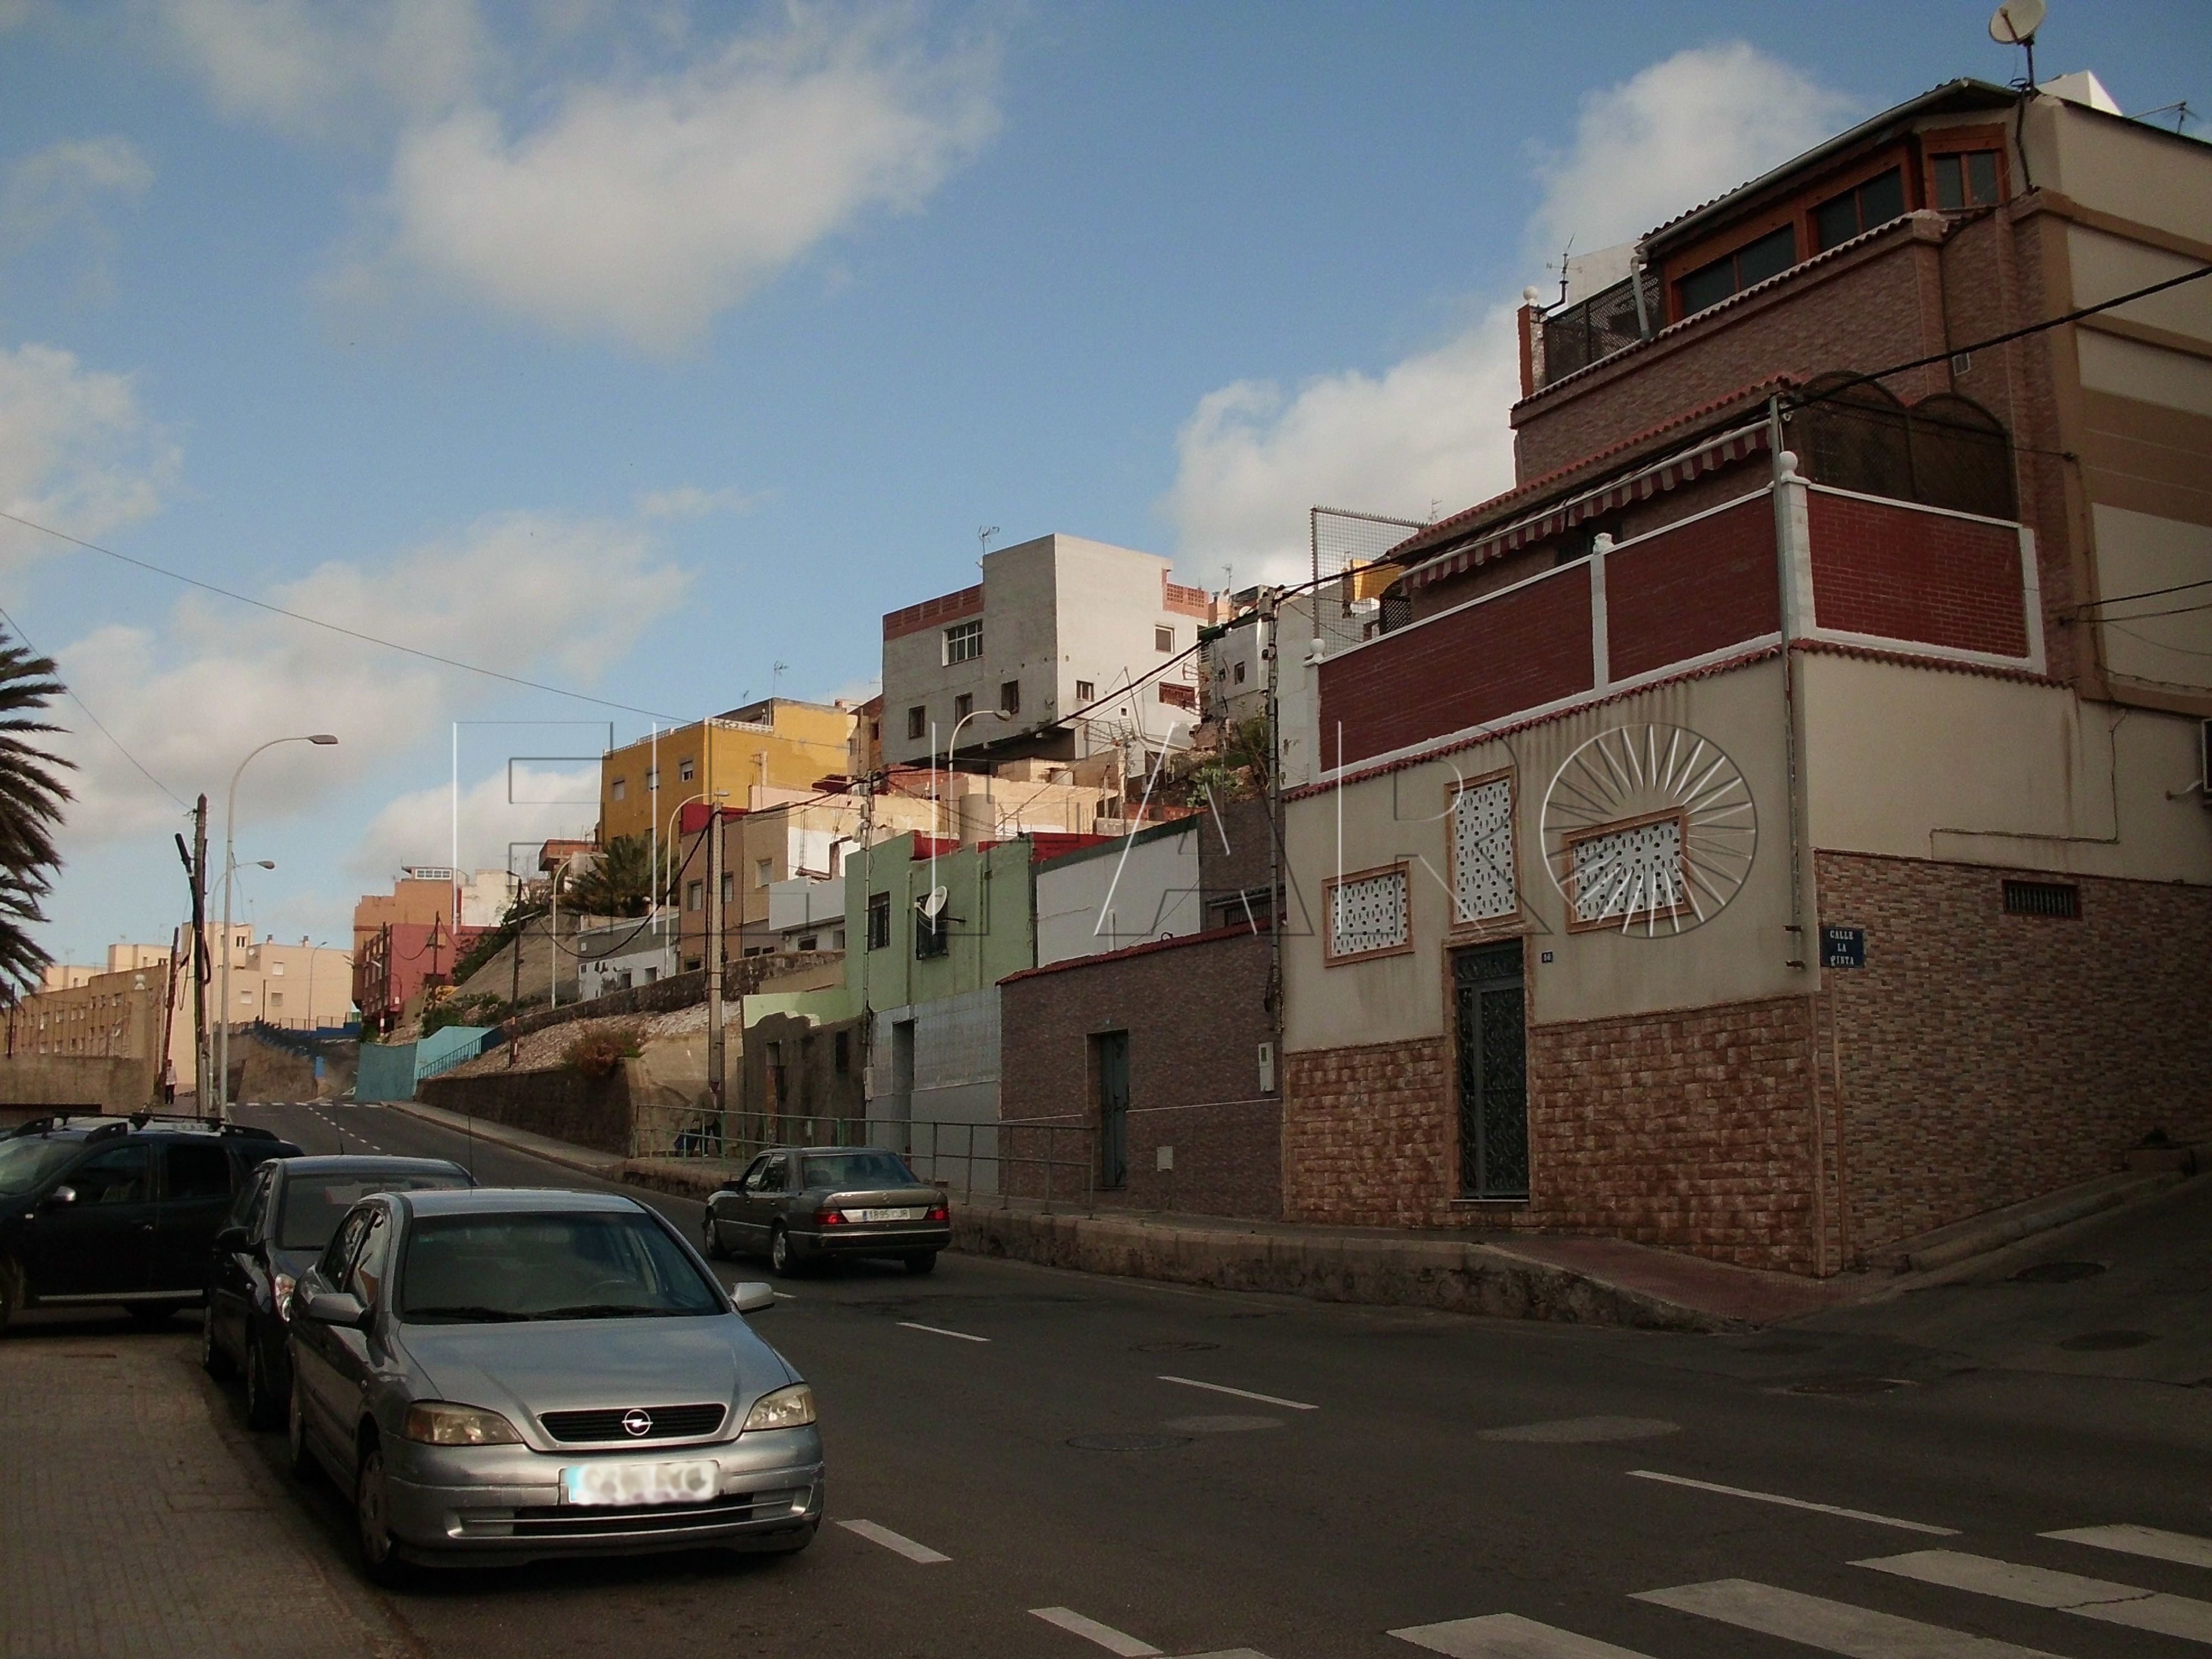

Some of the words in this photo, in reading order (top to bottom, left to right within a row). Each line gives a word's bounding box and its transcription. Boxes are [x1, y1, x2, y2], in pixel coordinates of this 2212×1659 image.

[1830, 930, 1853, 940] CALLE
[1838, 943, 1846, 952] LA
[1830, 955, 1854, 966] PINTA
